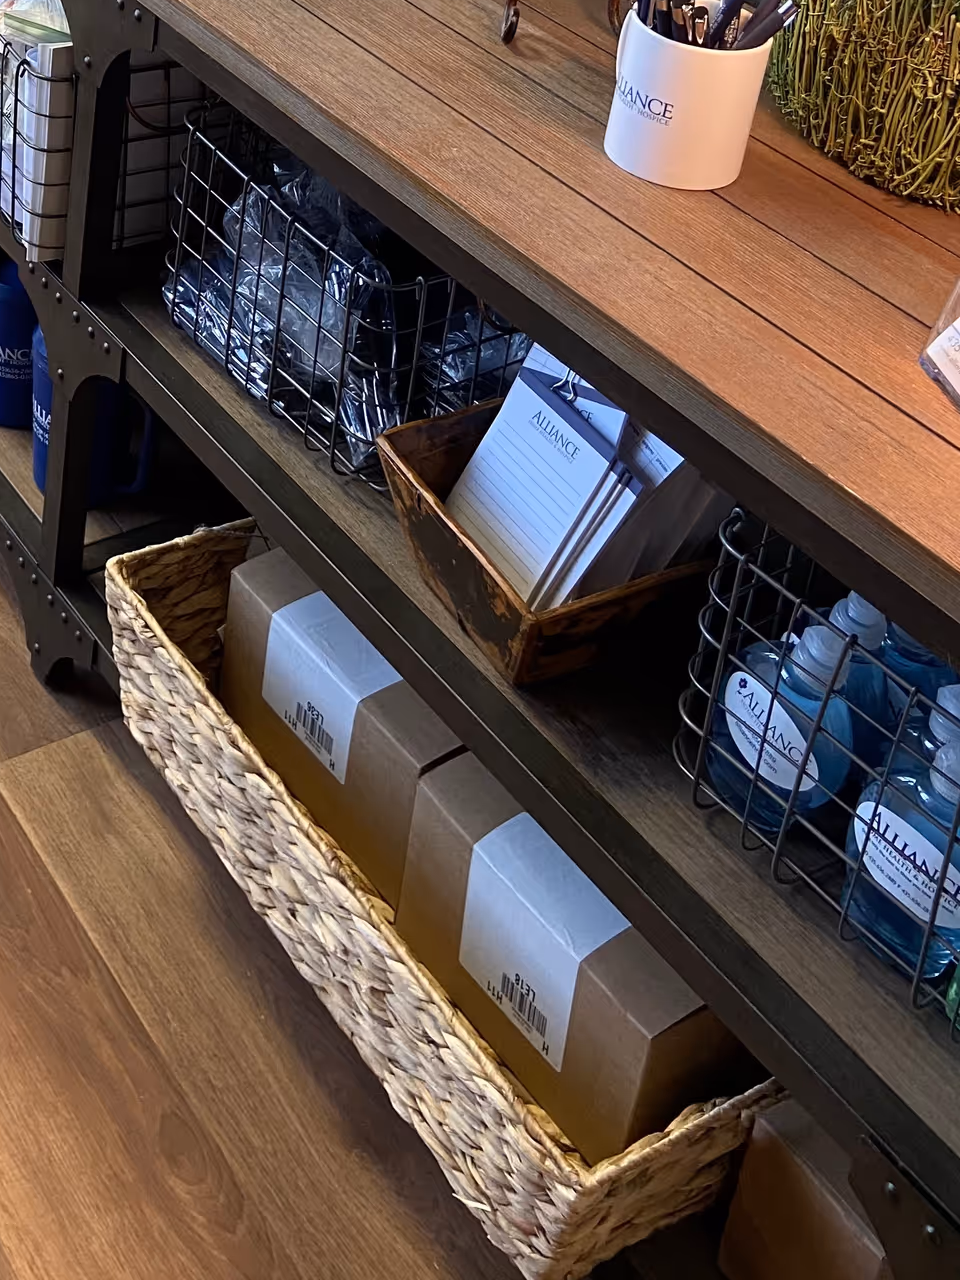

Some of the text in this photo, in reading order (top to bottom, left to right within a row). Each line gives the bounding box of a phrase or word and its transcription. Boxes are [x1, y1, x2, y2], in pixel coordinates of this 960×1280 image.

[637, 108, 670, 127] HOSPICE
[532, 410, 580, 460] ALLIANCE
[883, 844, 912, 875] HEALTH
[542, 1040, 549, 1056] H
